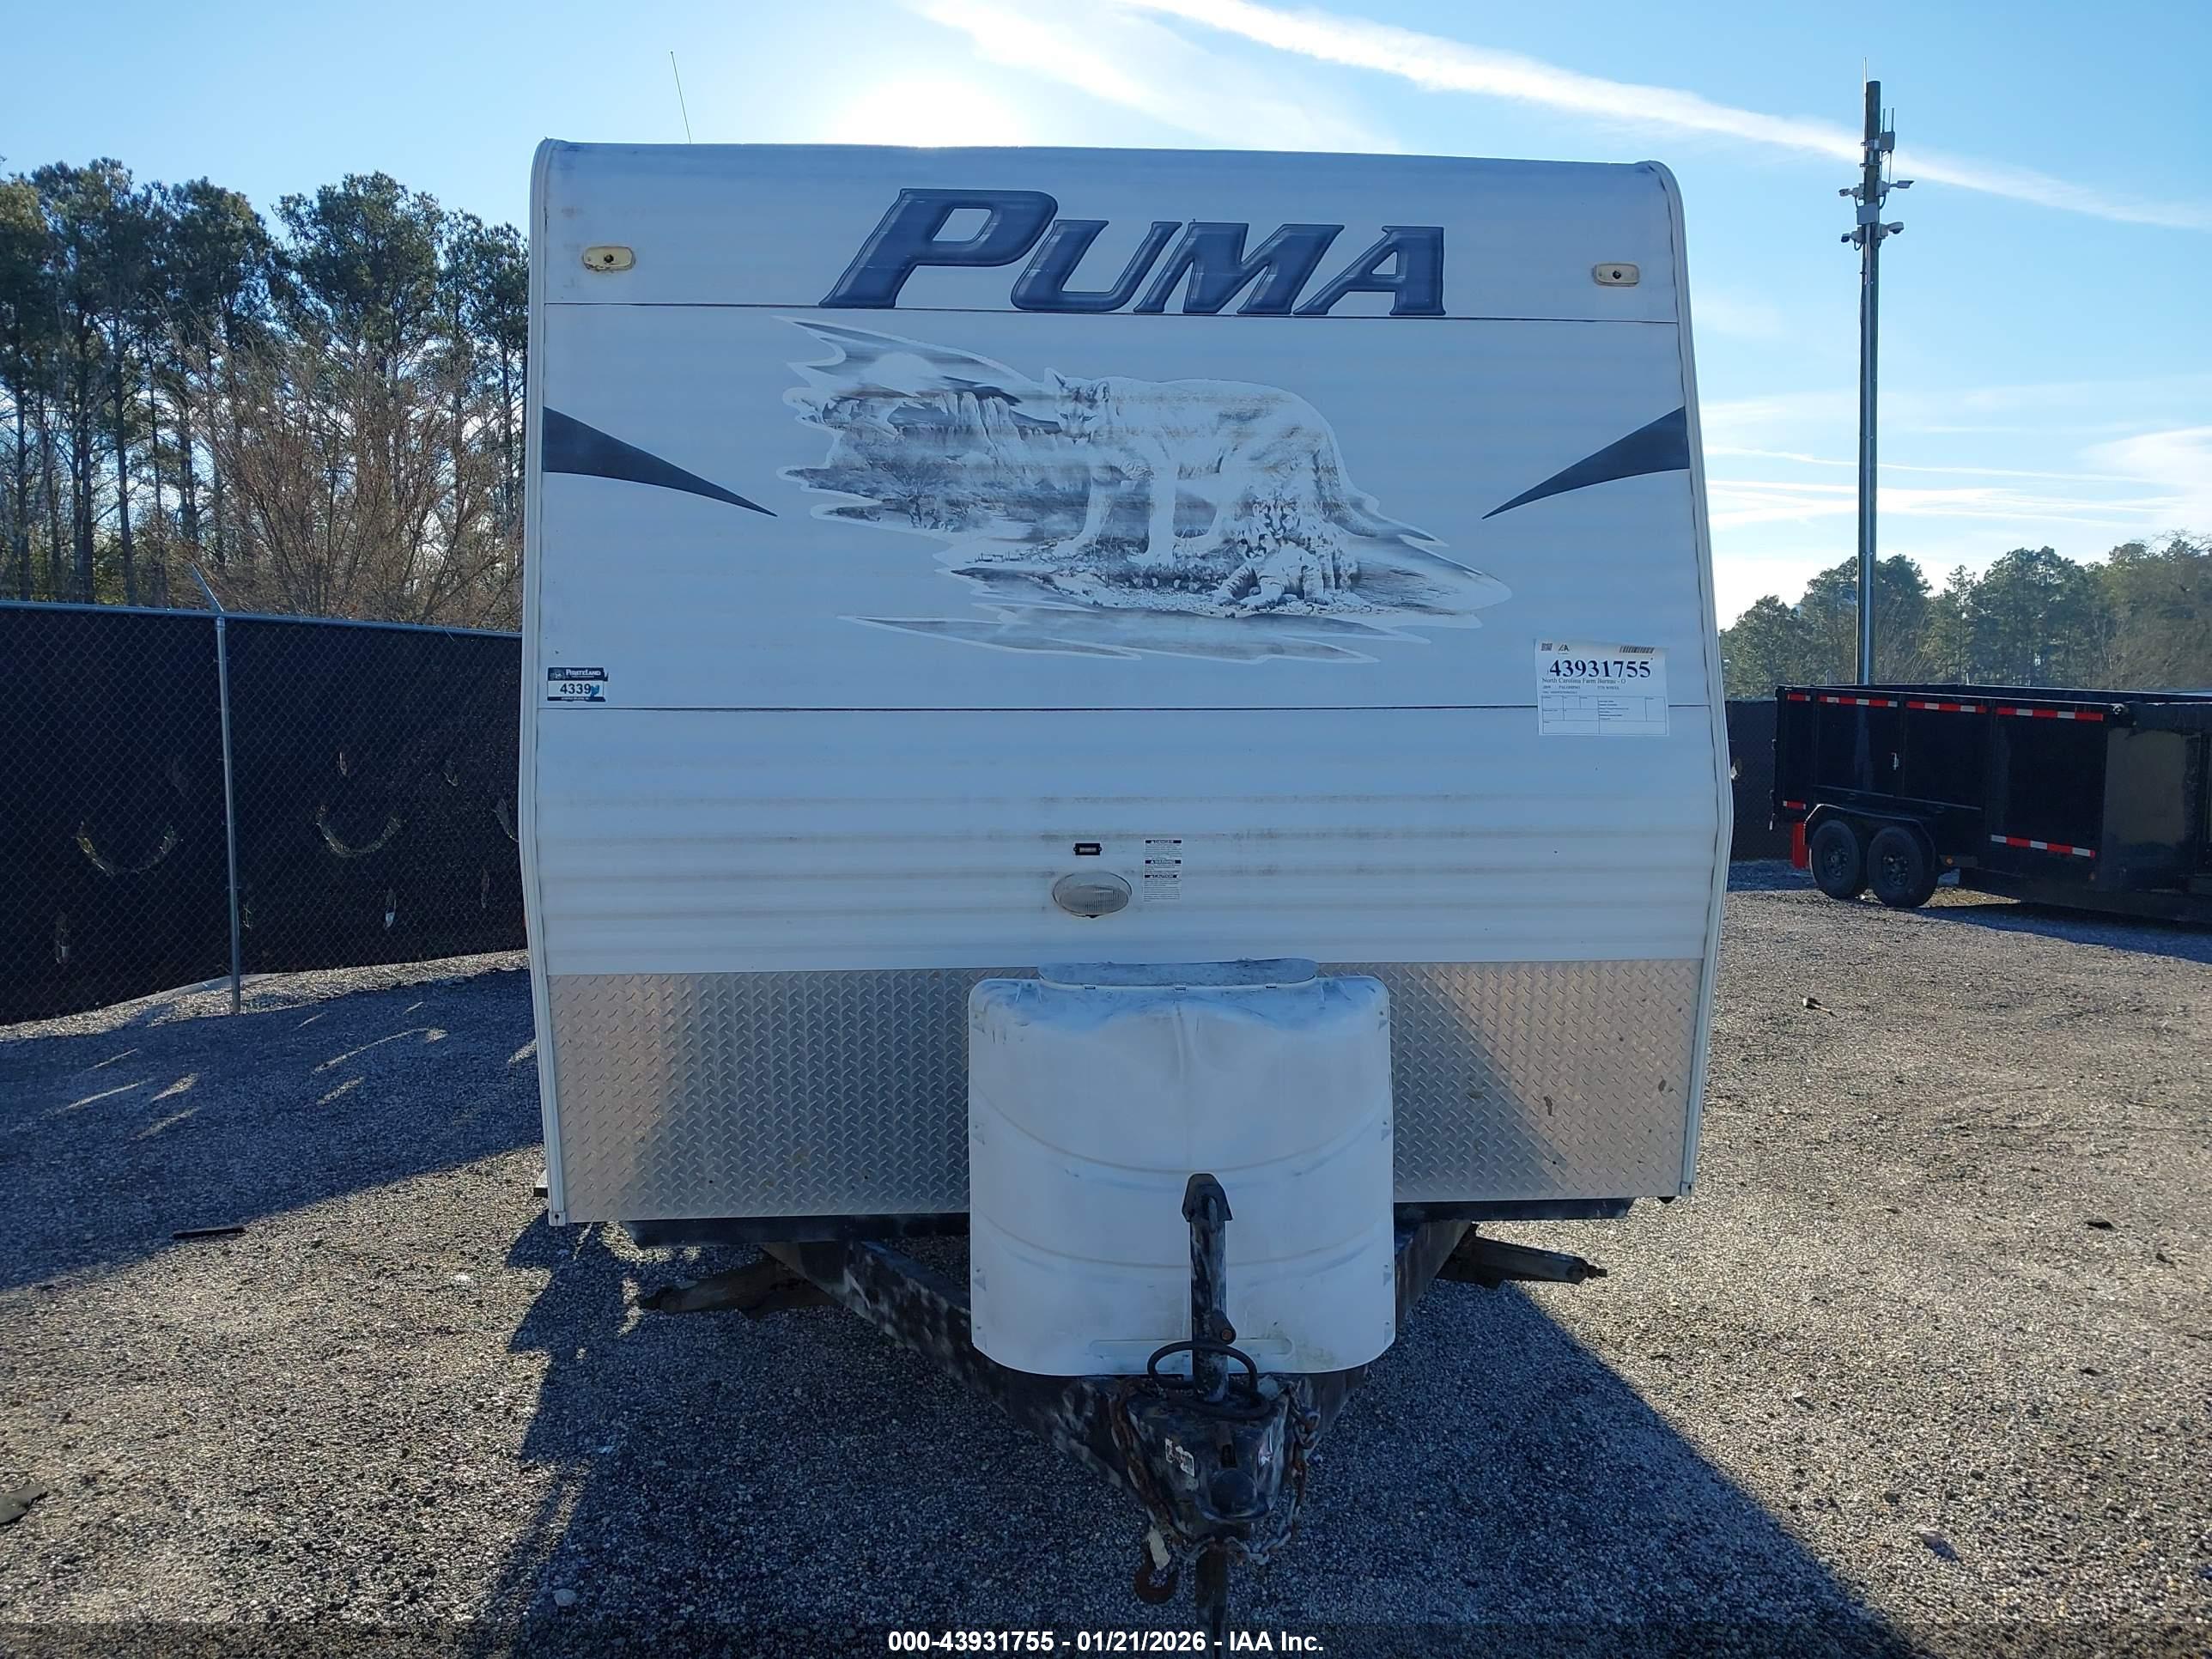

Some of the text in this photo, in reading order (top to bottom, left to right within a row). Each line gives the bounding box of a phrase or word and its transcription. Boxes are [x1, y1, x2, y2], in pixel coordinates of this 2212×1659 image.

[817, 187, 1446, 316] PUMA
[1549, 659, 1651, 678] 43931755
[560, 683, 592, 695] 4339
